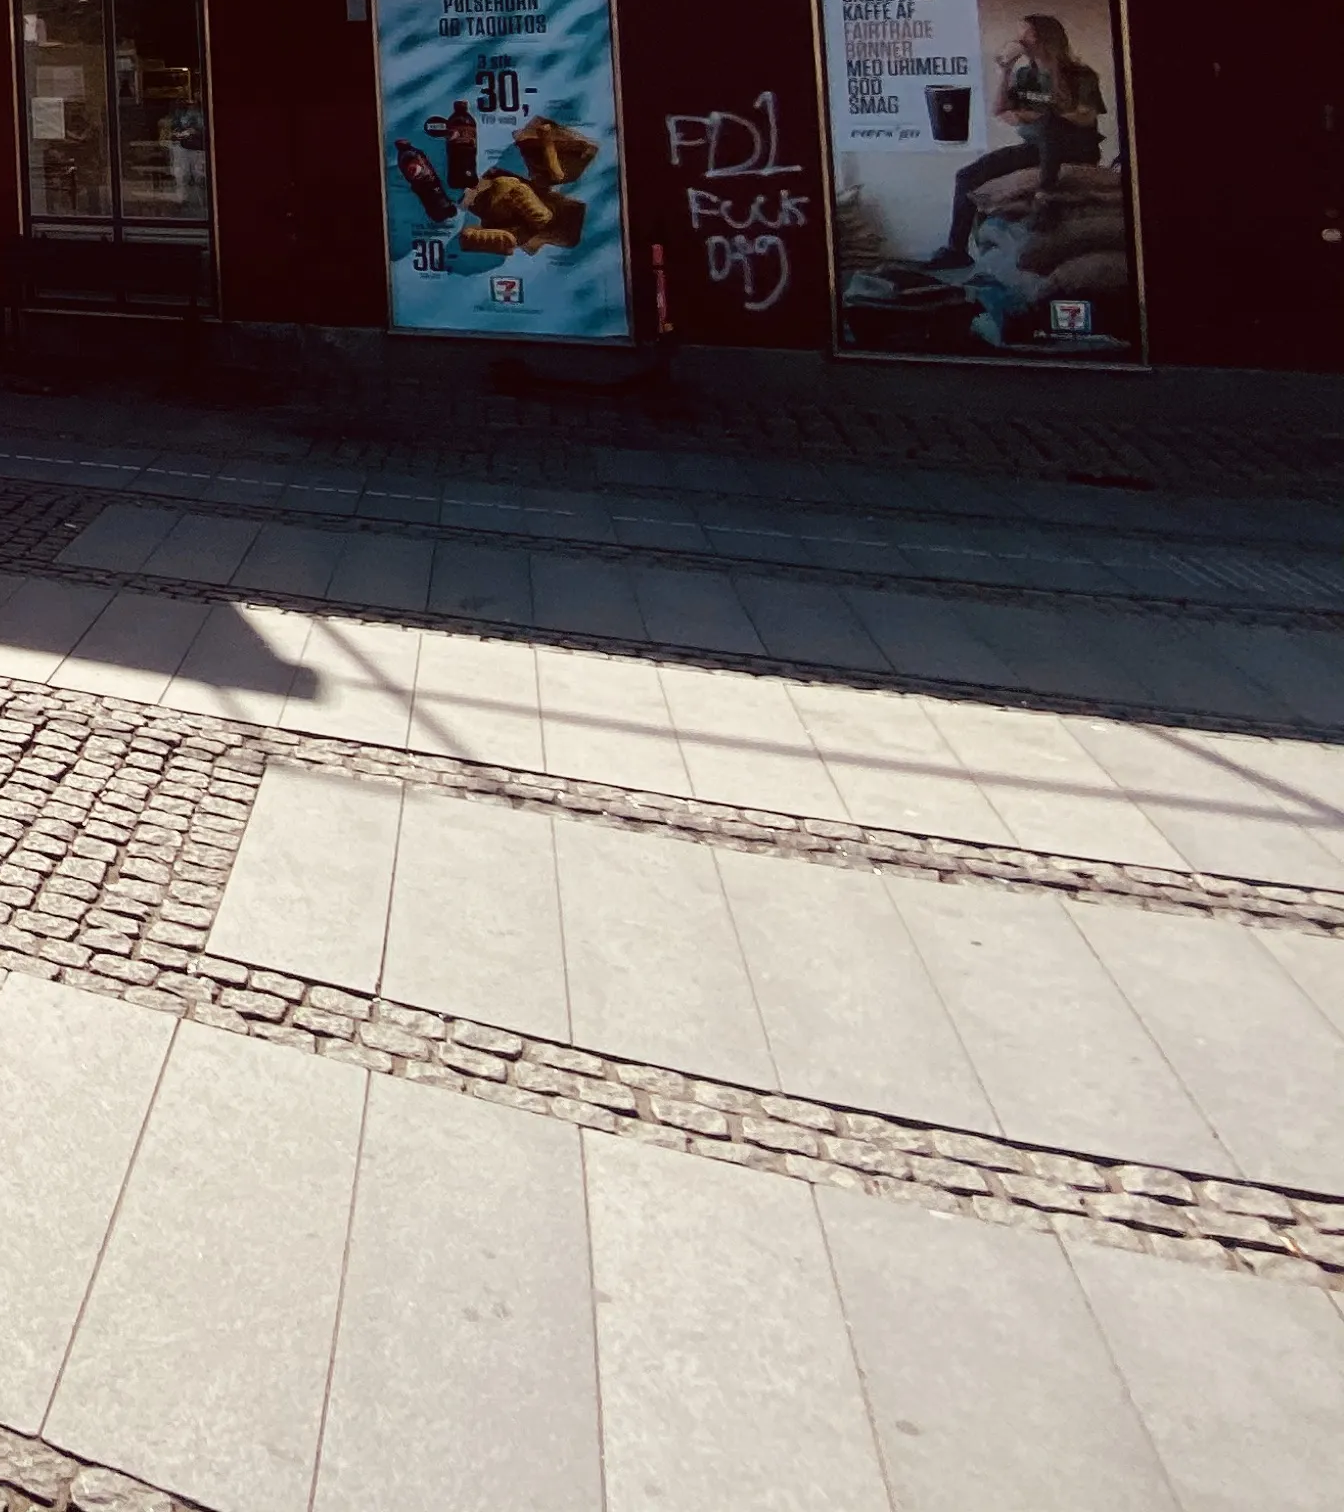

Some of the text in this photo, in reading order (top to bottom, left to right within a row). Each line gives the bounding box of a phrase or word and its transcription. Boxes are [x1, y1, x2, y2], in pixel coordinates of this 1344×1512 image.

[843, 2, 916, 21] KAFFE AF
[466, 15, 548, 37] TAQUITOS
[843, 20, 935, 40] FAIRTRADE
[845, 40, 913, 60] BØNNER
[846, 56, 968, 78] MED URIMELIG
[475, 71, 538, 117] 30,-
[847, 77, 883, 96] GOD
[848, 95, 900, 115] SMAG
